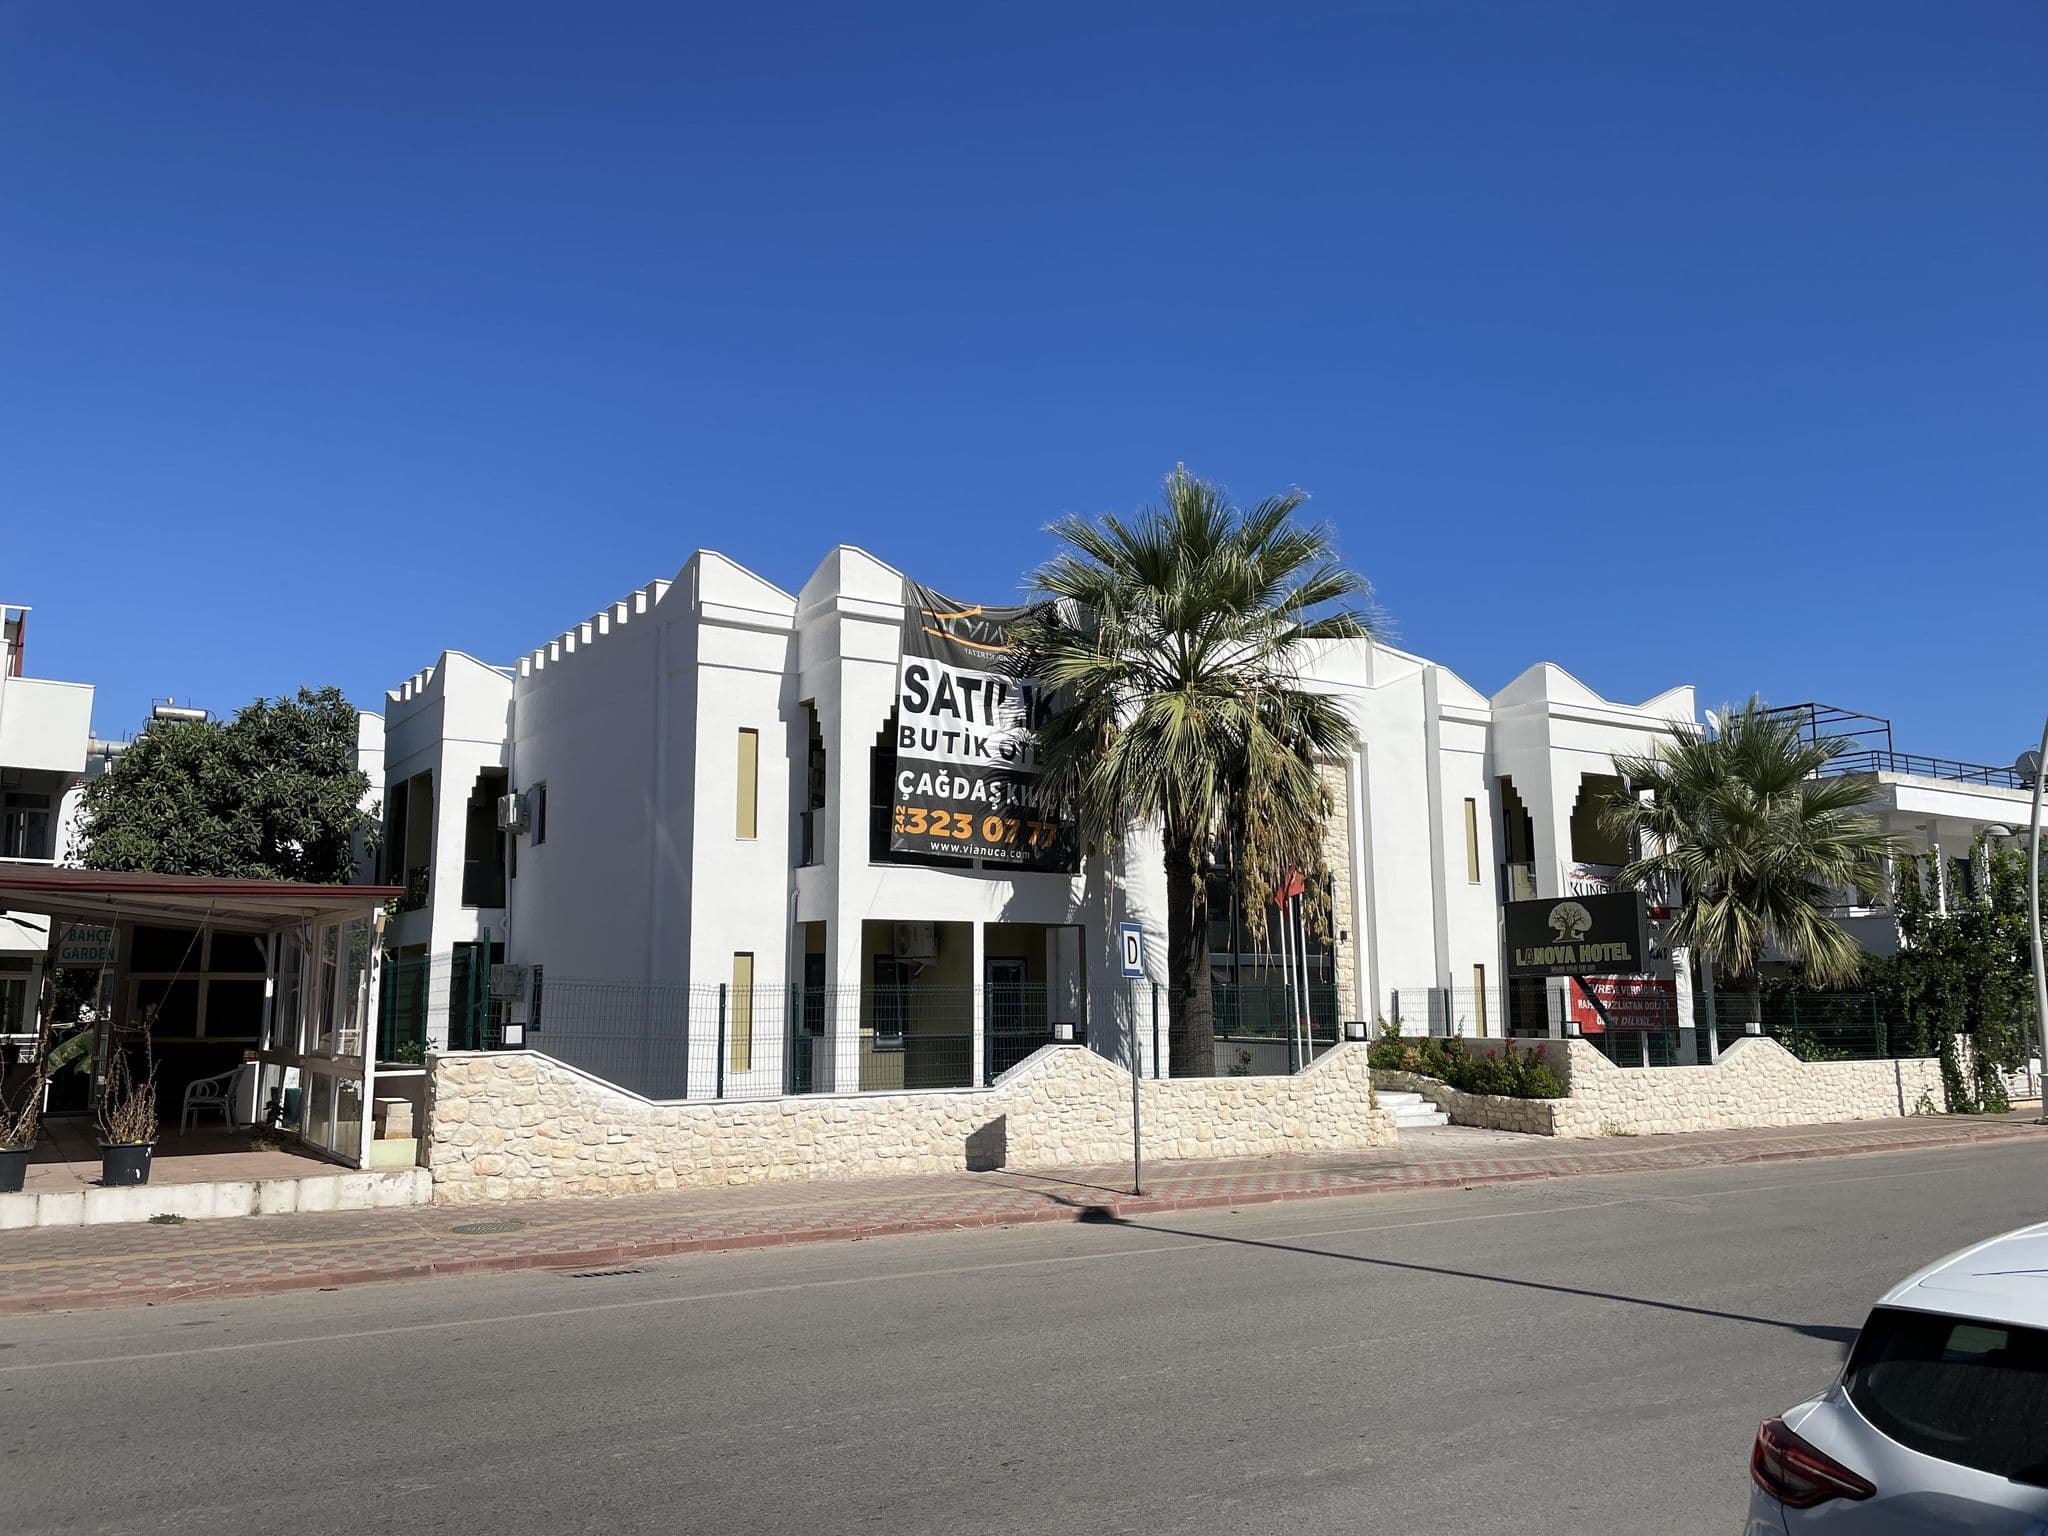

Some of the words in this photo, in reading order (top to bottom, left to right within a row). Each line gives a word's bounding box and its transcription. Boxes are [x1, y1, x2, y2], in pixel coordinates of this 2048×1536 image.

[899, 726, 992, 759] BUTİK
[897, 769, 1003, 810] ÇAĞDAŞ
[894, 805, 906, 833] 242
[904, 807, 973, 839] 323
[982, 815, 1021, 844] 07
[1025, 821, 1058, 848] 77
[930, 841, 1030, 860] www.vianuca.com
[68, 928, 112, 945] BAHÇE
[62, 947, 115, 960] GARDEN
[1127, 936, 1138, 964] D
[1515, 946, 1576, 966] LANOVA
[1580, 942, 1632, 963] HOTEL
